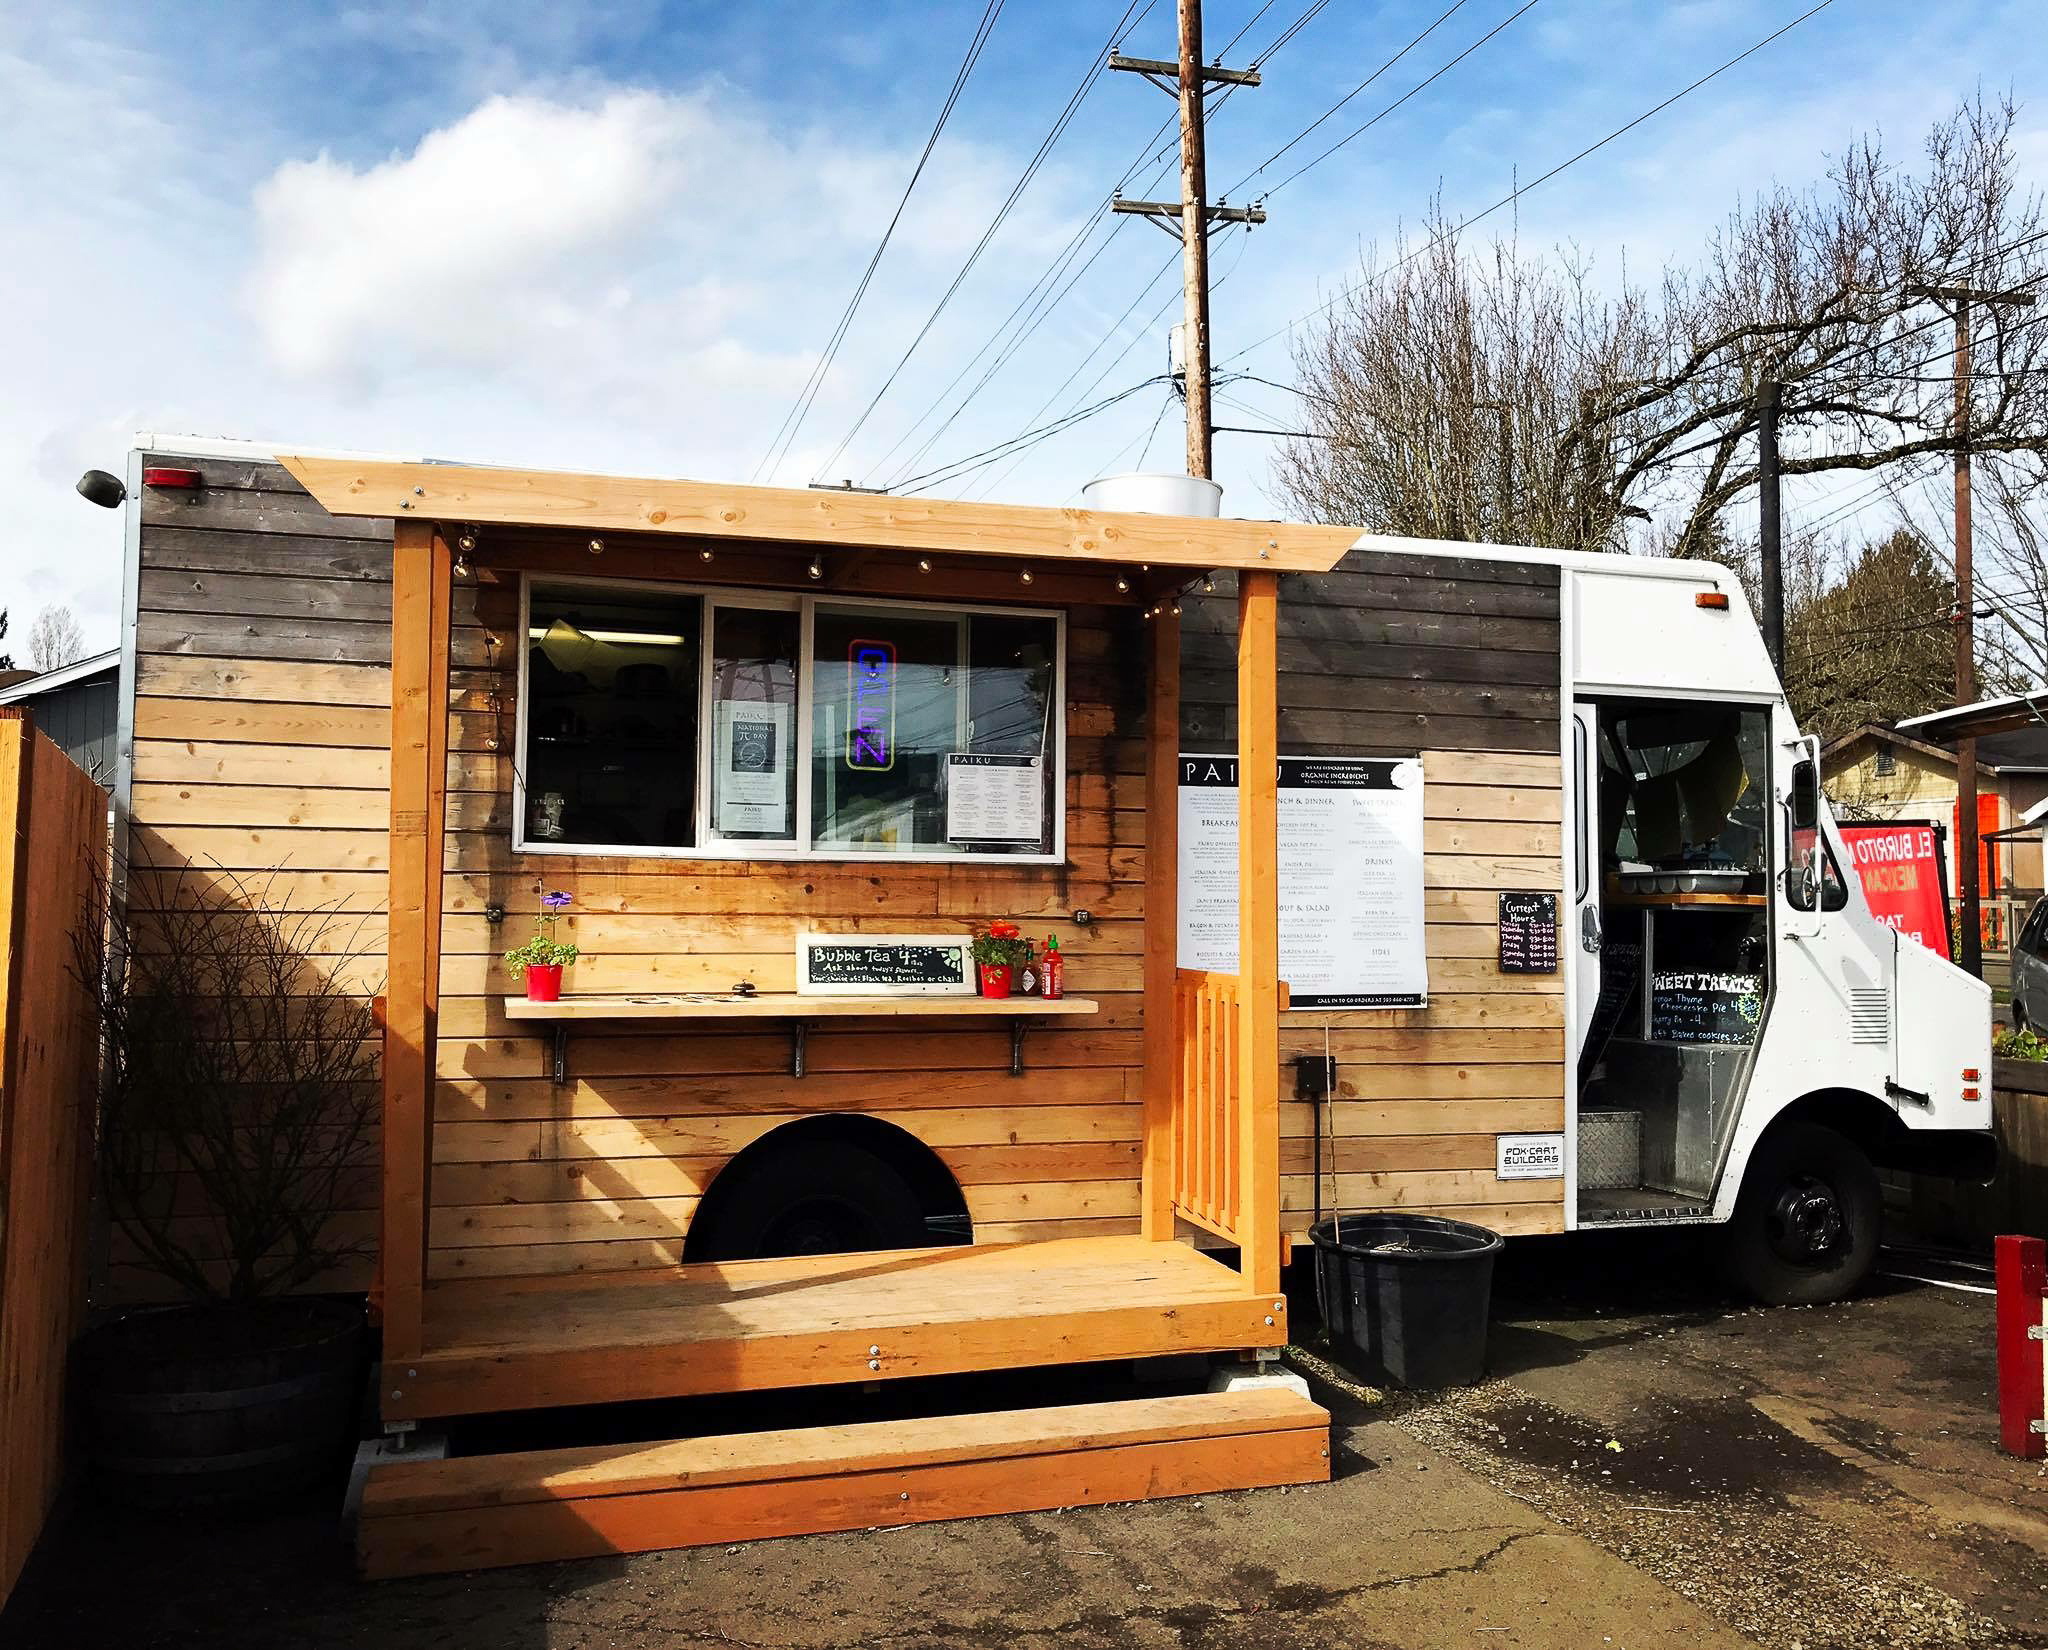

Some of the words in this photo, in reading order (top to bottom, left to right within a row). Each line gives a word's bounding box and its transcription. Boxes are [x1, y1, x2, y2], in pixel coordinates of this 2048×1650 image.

[855, 648, 888, 765] OPEN
[737, 724, 774, 733] NATIONAL
[954, 756, 991, 765] PAIKU
[1305, 798, 1335, 806] DINNER
[1365, 857, 1393, 865] DRINKS
[1505, 900, 1541, 914] Current
[1510, 912, 1537, 923] Hours
[814, 948, 862, 962] Bubble
[865, 949, 891, 963] Tea
[822, 963, 843, 973] Ask
[862, 974, 881, 982] Black
[1698, 974, 1755, 993] TREATS
[1675, 993, 1703, 1005] Thyme
[1712, 1002, 1727, 1013] Pie
[1654, 1016, 1672, 1026] herry
[1672, 1030, 1695, 1039] Baked
[1698, 1031, 1730, 1040] cookies
[1503, 1155, 1559, 1165] BUILDERS
